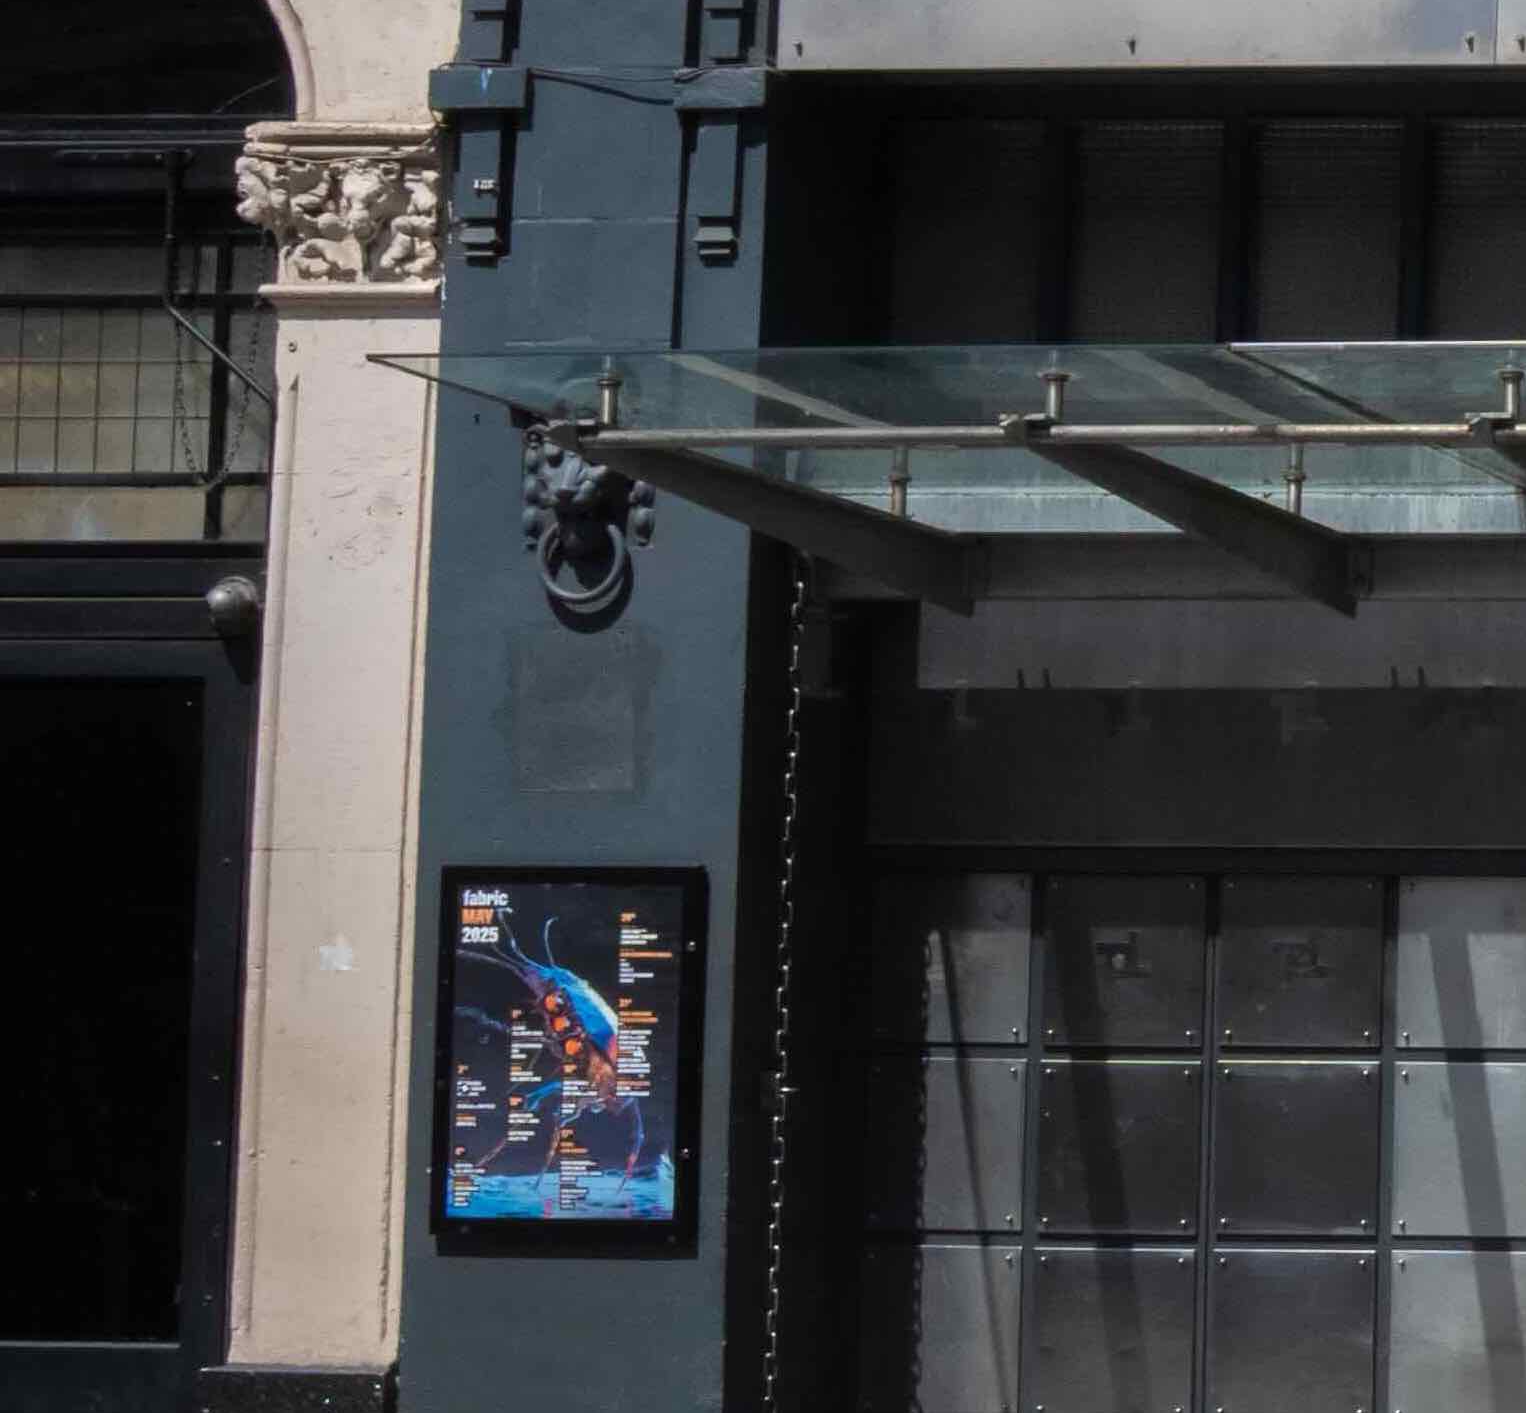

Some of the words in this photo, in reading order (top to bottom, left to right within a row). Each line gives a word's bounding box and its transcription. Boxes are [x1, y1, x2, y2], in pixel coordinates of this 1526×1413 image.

[462, 890, 509, 906] fabric
[462, 908, 494, 924] MAY
[462, 927, 499, 943] 2025
